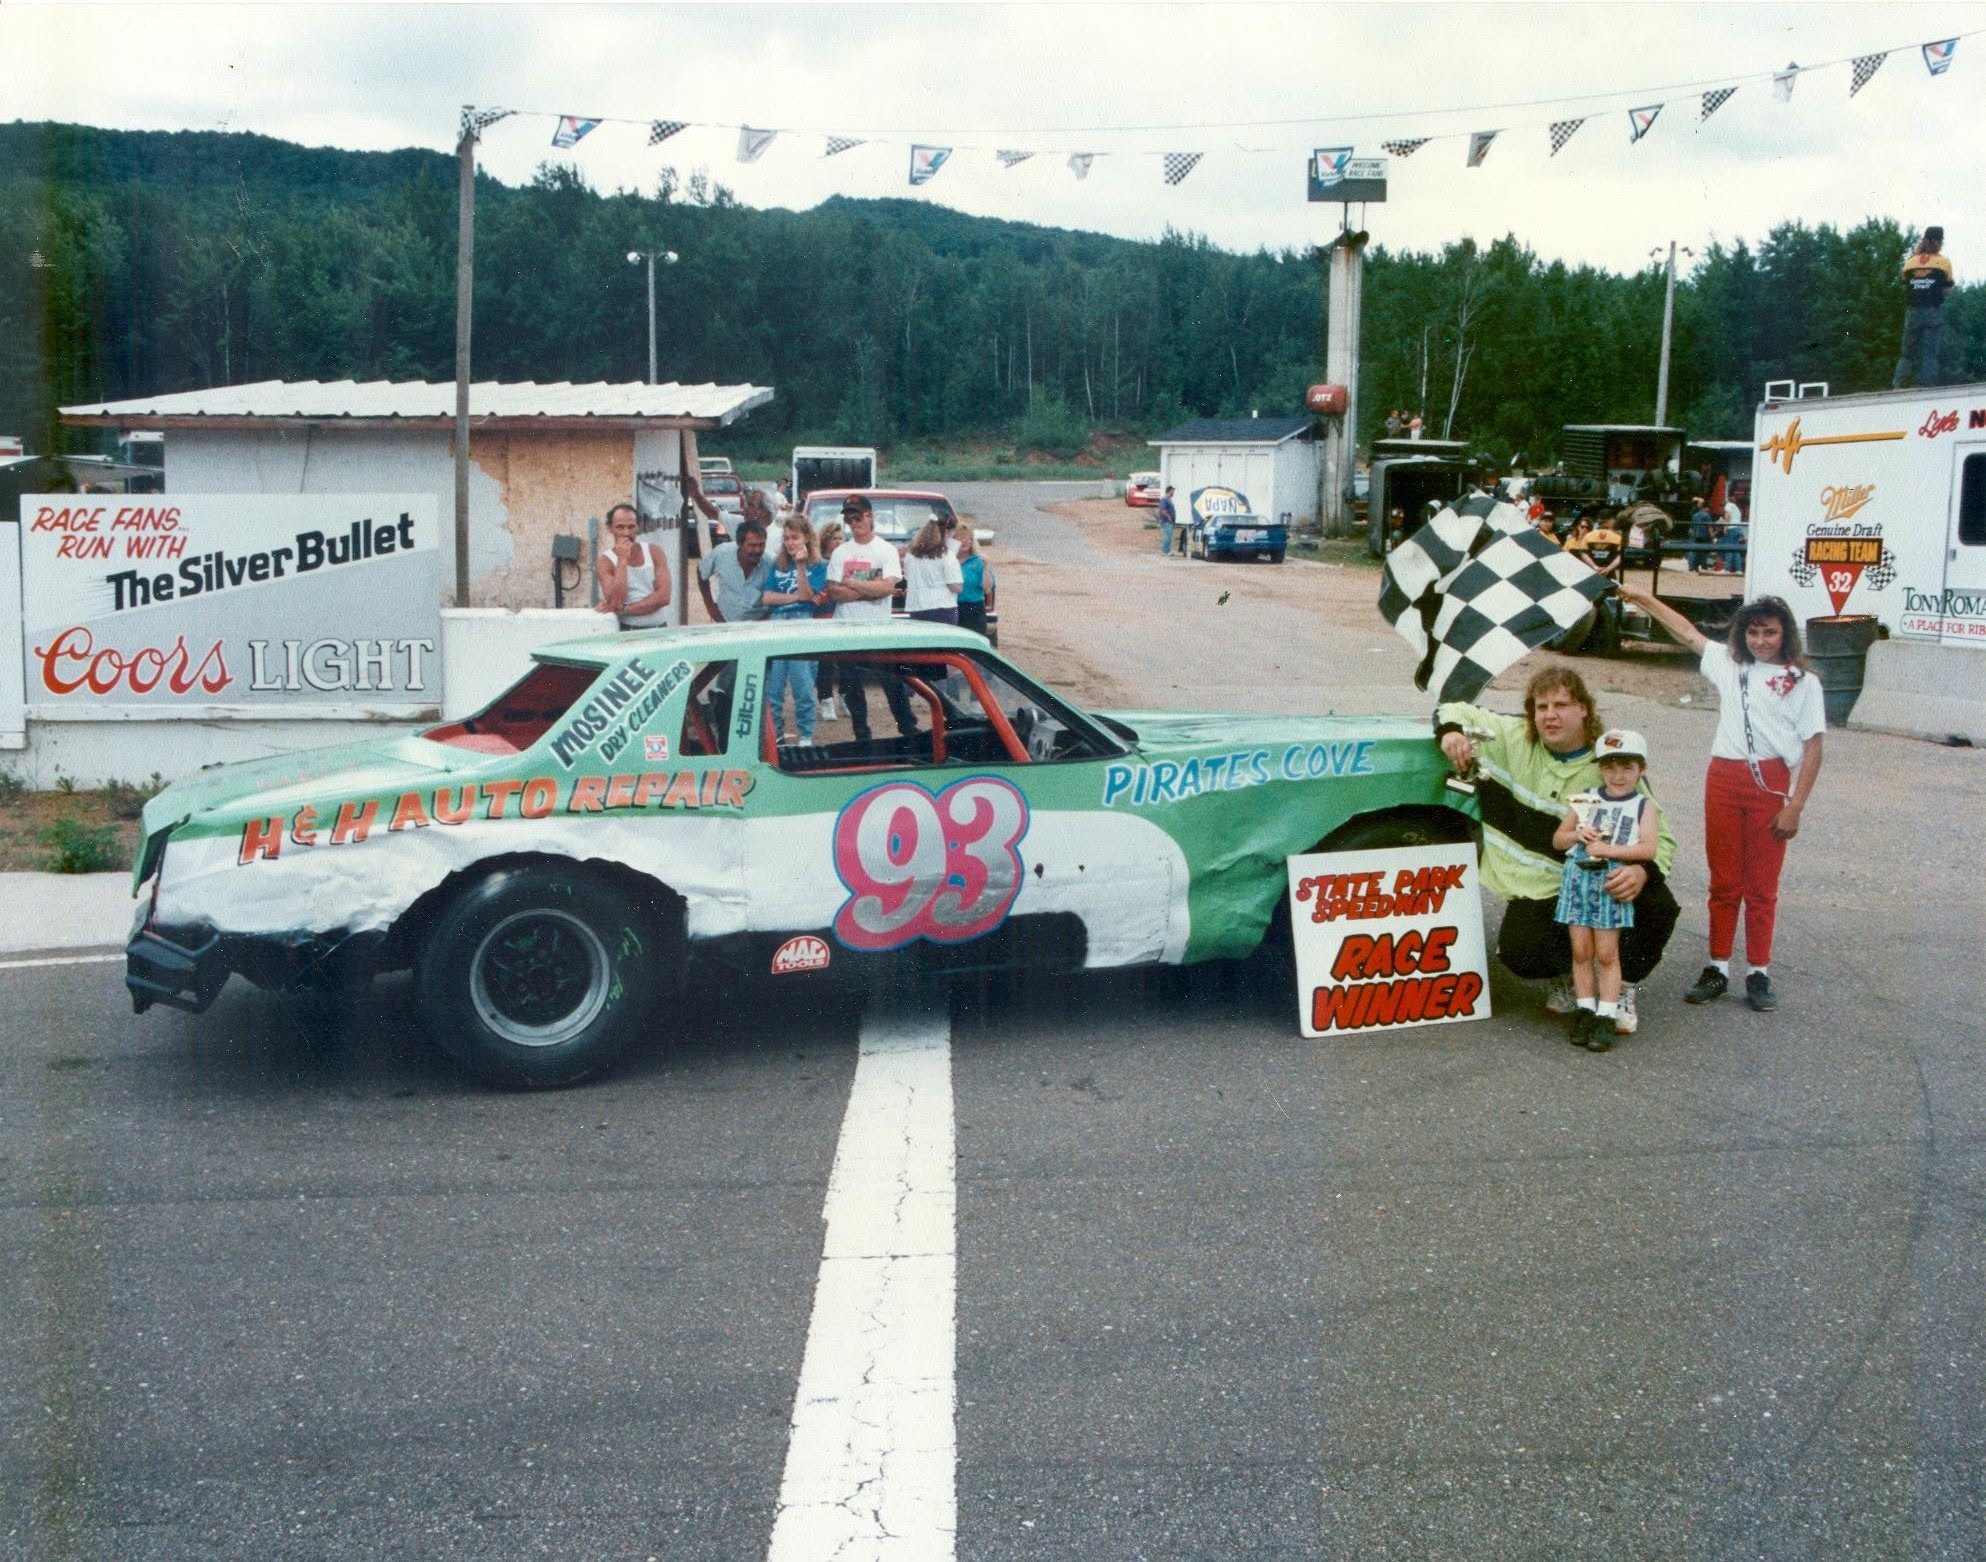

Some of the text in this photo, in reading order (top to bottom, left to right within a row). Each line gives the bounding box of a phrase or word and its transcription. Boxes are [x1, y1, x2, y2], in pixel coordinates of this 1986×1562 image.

[30, 507, 104, 532] RACE
[1821, 484, 1876, 520] Miller
[57, 534, 188, 559] RUN WITH
[1806, 522, 1883, 537] Genuine Draft
[106, 512, 416, 611] The Silver Bullet
[1809, 541, 1880, 563] RACING TEAM
[1828, 571, 1852, 593] 32
[1917, 620, 1943, 632] PLACE
[1947, 622, 1965, 635] FOR
[34, 626, 436, 695] Coors LIGHT
[550, 657, 658, 769] MOSINEE
[599, 725, 630, 766] DRY
[627, 659, 694, 733] CLEANERS
[735, 673, 758, 738] tilton
[1103, 740, 1376, 806] PIRATES COVE
[237, 769, 756, 866] H & H AUTO REPAIR
[838, 776, 1028, 946] 93
[1295, 864, 1468, 902] STATE PARK
[1311, 889, 1448, 923] SPEEDWAY
[776, 939, 827, 963] MAC
[778, 959, 826, 971] TOOLS
[1330, 926, 1459, 982] RACE
[1311, 971, 1484, 1032] WINNER
